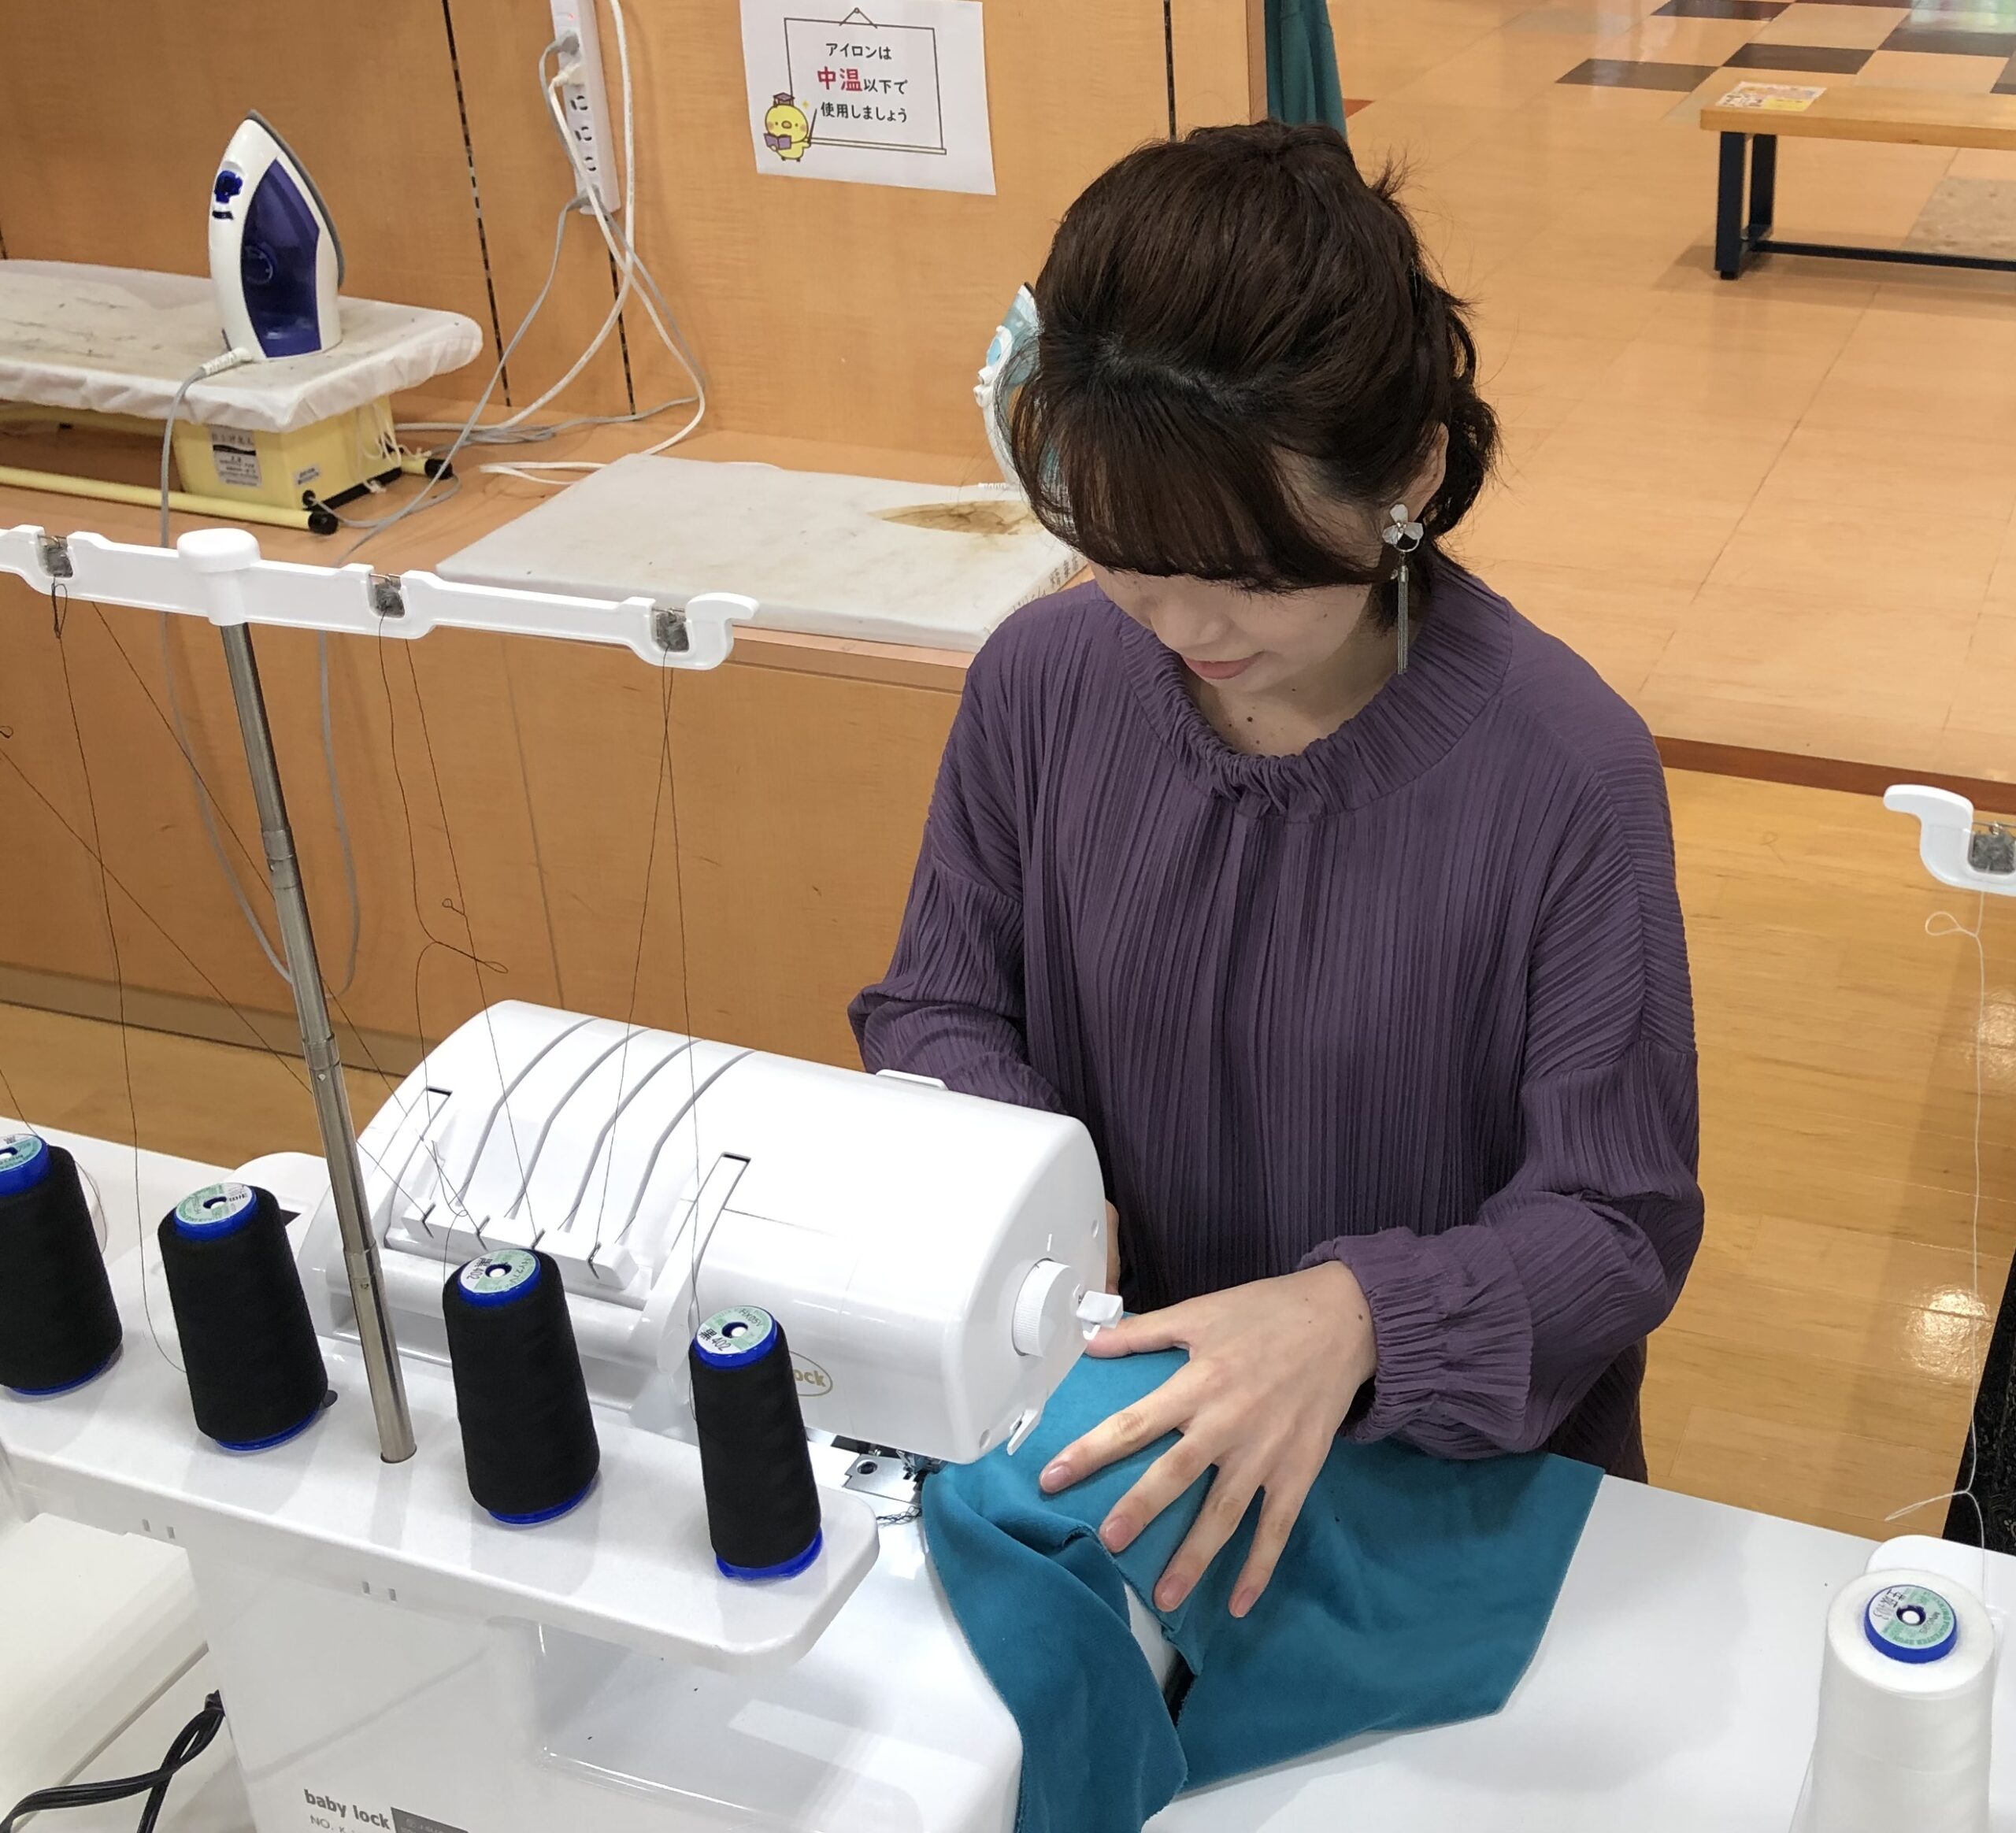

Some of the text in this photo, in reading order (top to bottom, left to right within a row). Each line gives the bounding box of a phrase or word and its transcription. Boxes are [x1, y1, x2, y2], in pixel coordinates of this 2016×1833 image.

[826, 43, 892, 60] アイロンは
[817, 66, 908, 94] 中温以下で
[821, 102, 908, 123] 使用しましょう
[793, 1368, 826, 1387] ock
[304, 1788, 346, 1818] baby
[352, 1805, 391, 1830] lock
